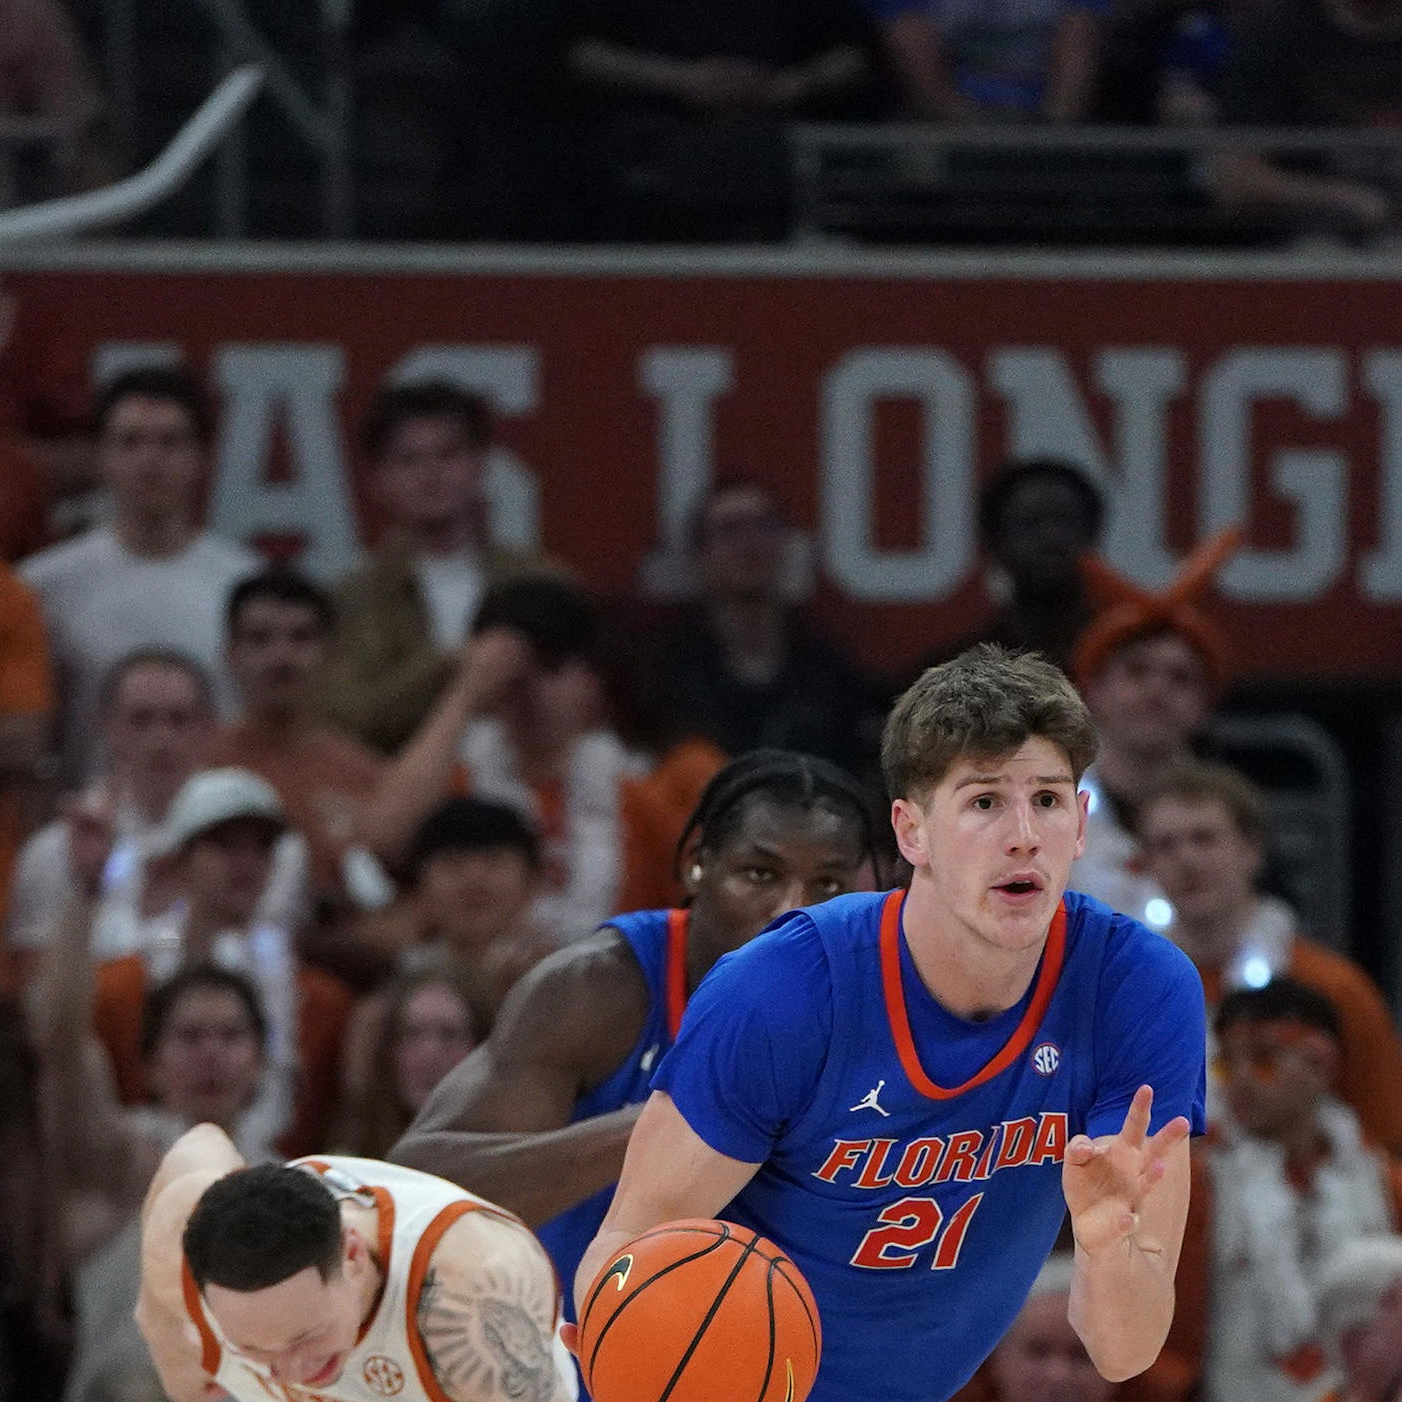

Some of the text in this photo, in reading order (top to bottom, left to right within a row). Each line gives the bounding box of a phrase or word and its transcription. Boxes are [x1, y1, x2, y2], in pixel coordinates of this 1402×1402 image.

[1033, 1044, 1060, 1074] SEC
[811, 1111, 1068, 1189] FLORIDA
[849, 1192, 985, 1271] 21
